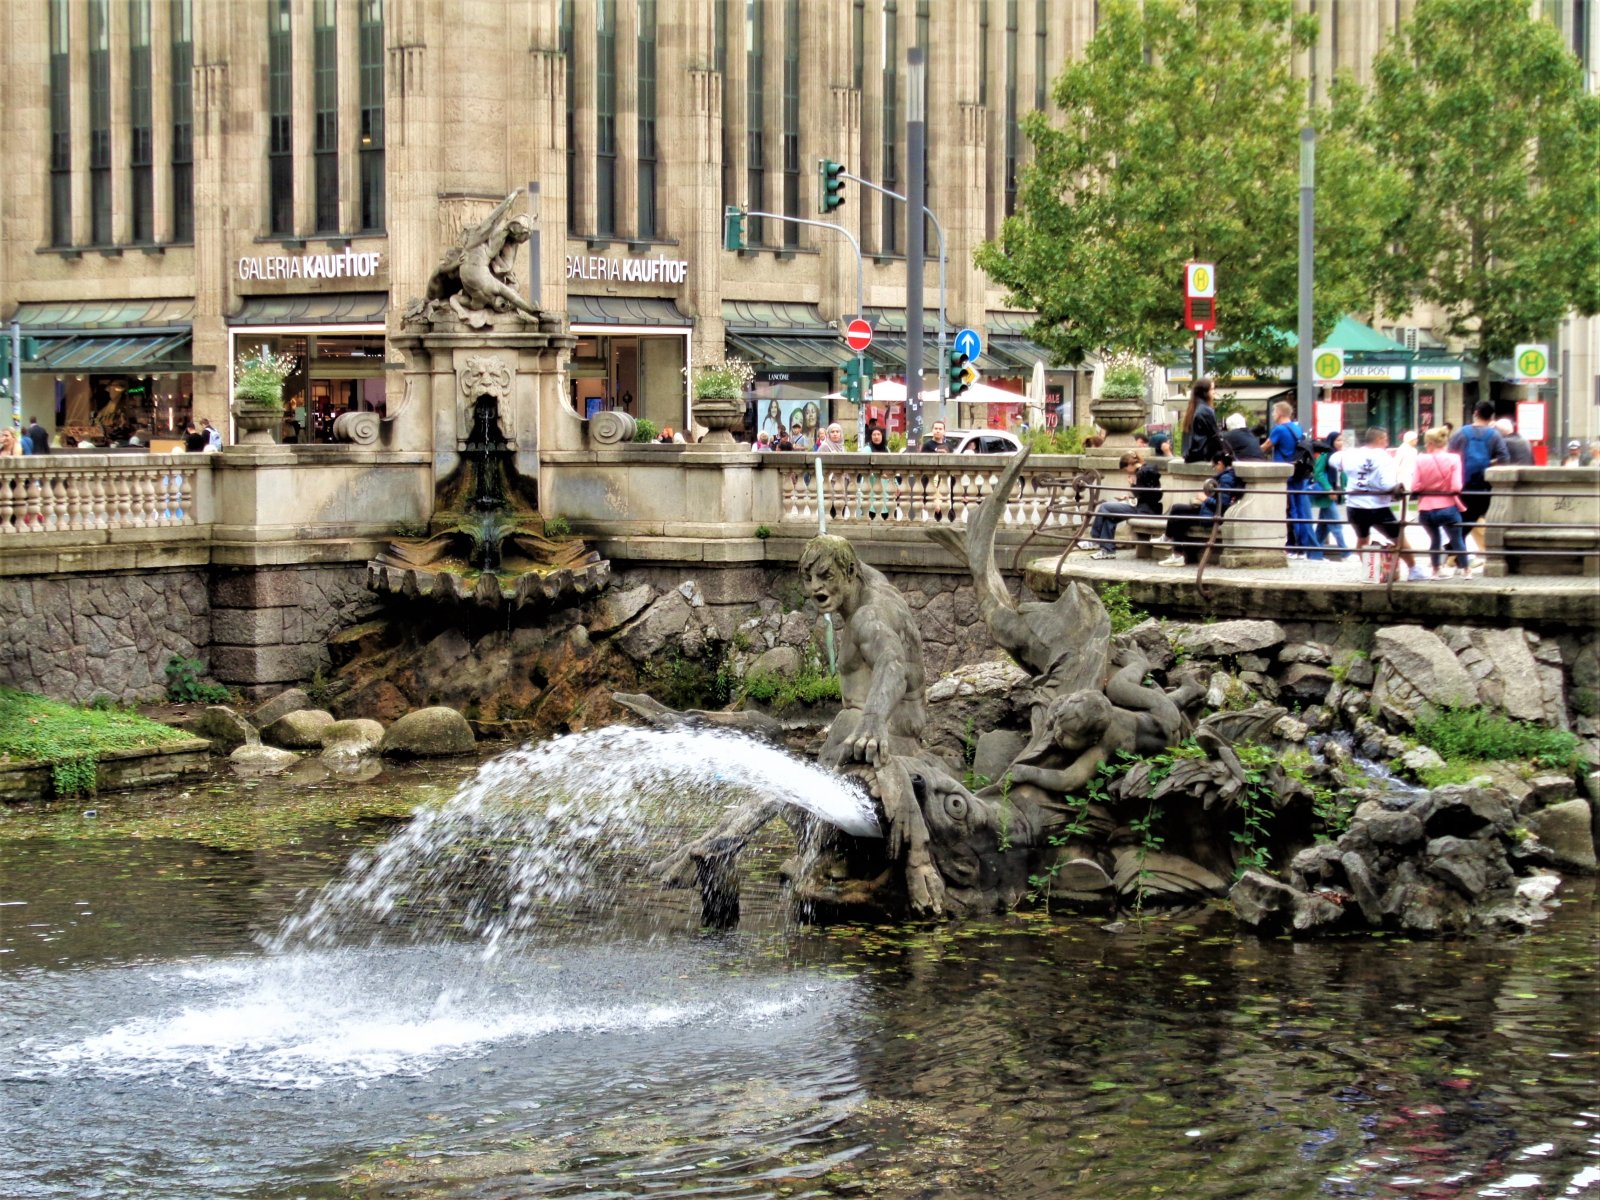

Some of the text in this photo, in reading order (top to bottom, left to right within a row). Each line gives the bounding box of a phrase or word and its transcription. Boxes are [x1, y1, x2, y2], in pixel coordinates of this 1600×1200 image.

[239, 256, 301, 280] GALERIA
[1367, 366, 1391, 376] POST
[1331, 388, 1366, 403] KIOSK
[1046, 412, 1059, 428] 70
